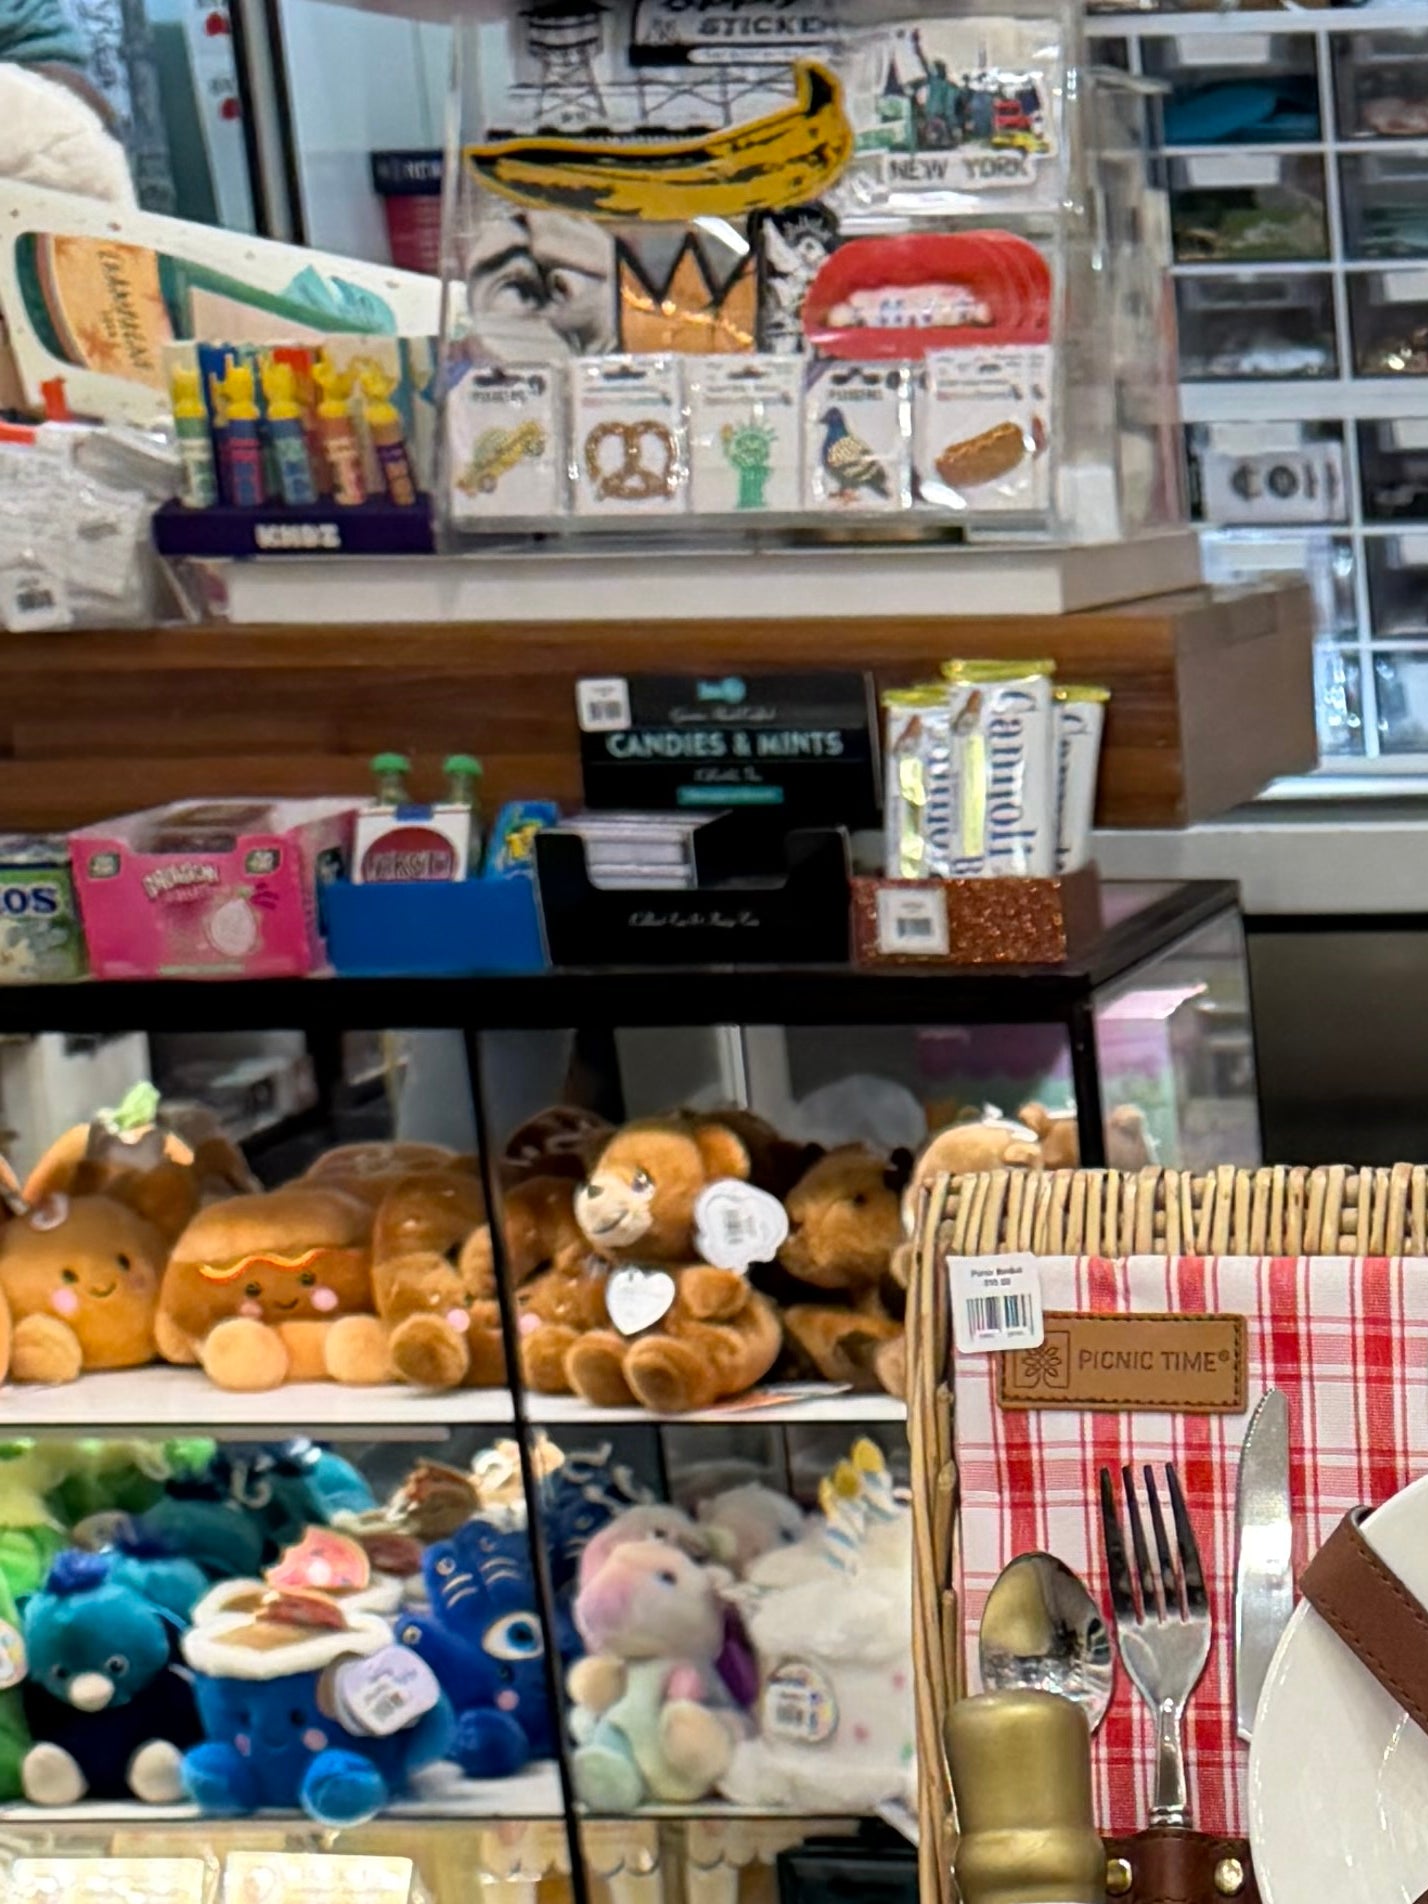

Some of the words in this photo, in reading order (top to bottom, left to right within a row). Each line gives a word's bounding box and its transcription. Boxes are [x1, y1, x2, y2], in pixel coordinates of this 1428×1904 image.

[889, 159, 949, 180] NEW
[964, 158, 1028, 179] YORK
[606, 731, 727, 758] CANDIES
[733, 731, 751, 757] &
[758, 730, 845, 757] MINTS
[1078, 1349, 1154, 1372] PICNIC
